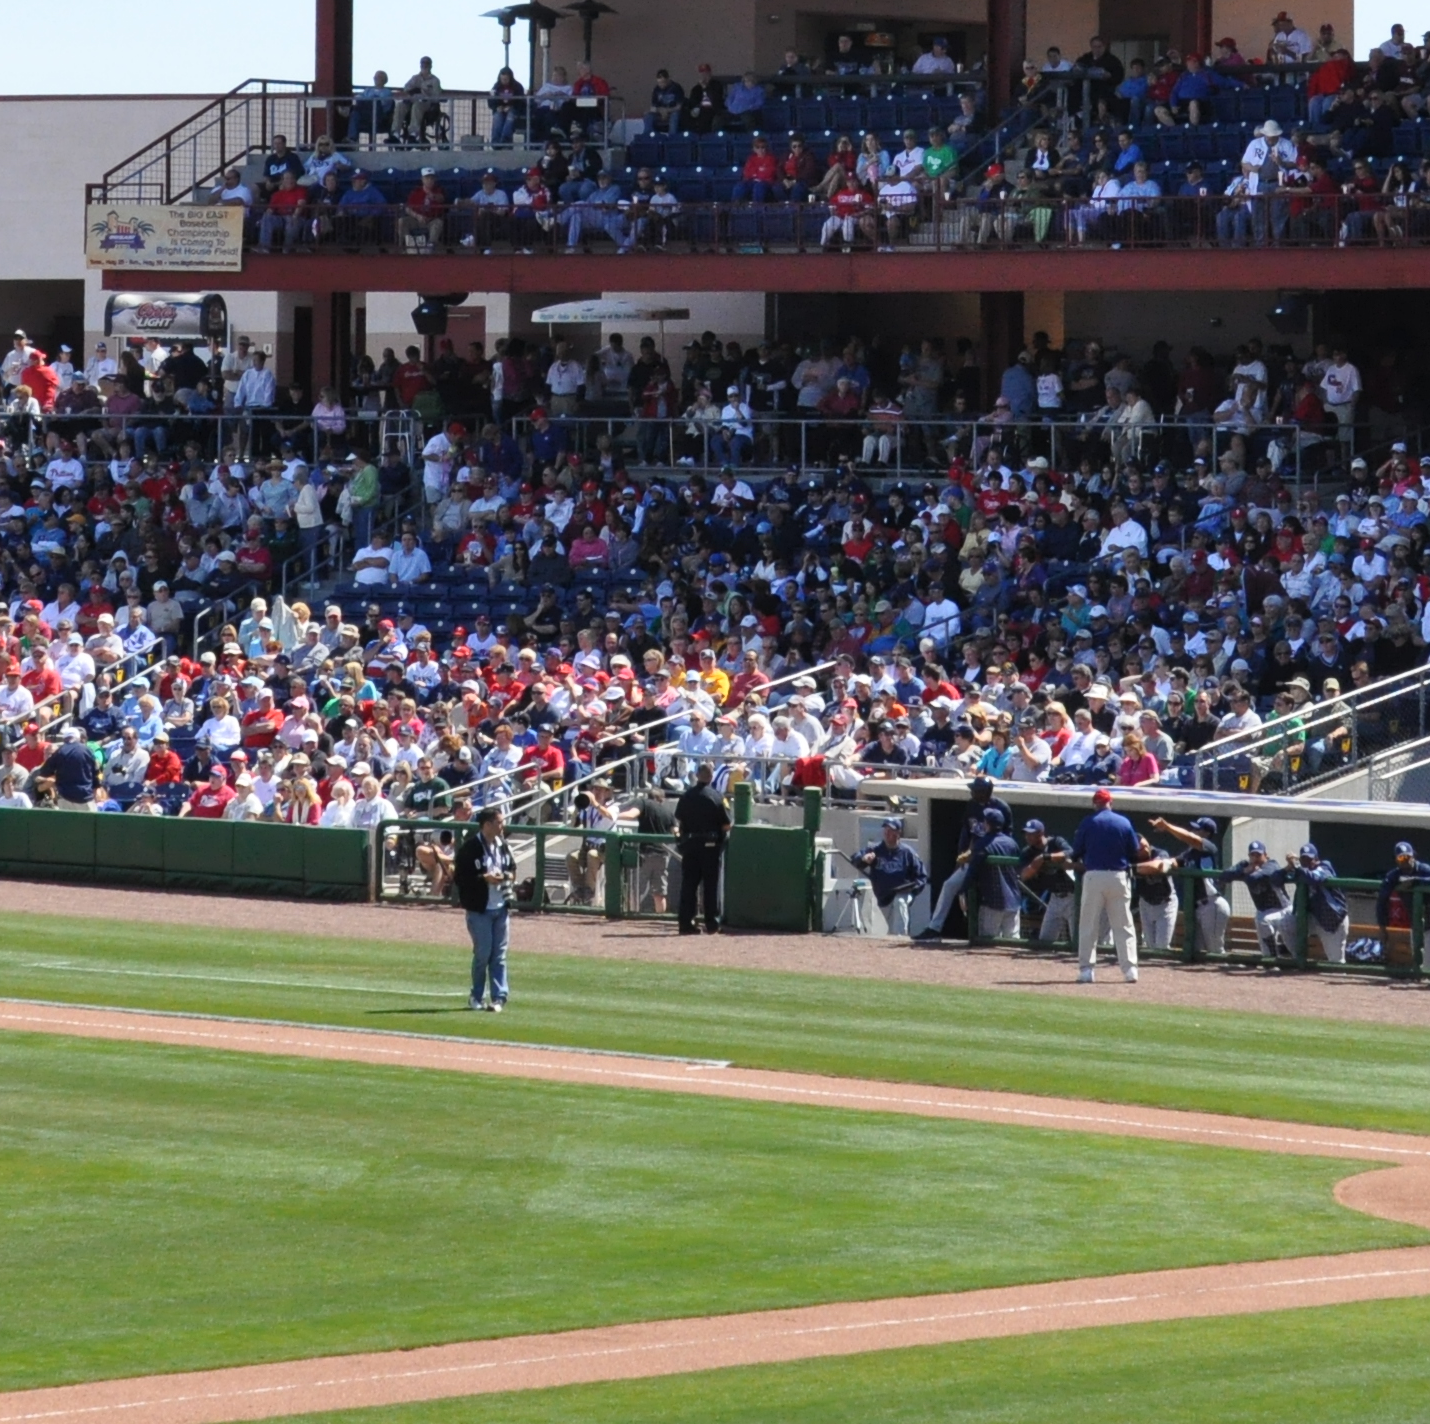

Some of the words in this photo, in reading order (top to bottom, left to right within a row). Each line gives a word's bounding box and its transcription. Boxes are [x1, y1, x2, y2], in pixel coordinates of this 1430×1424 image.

[206, 210, 230, 219] EAST
[179, 219, 219, 228] Baseball
[167, 228, 230, 239] Championship
[180, 238, 214, 249] Coming
[156, 246, 182, 257] Bright
[184, 247, 212, 256] House
[138, 302, 178, 319] Coors
[137, 317, 173, 328] LIGHT
